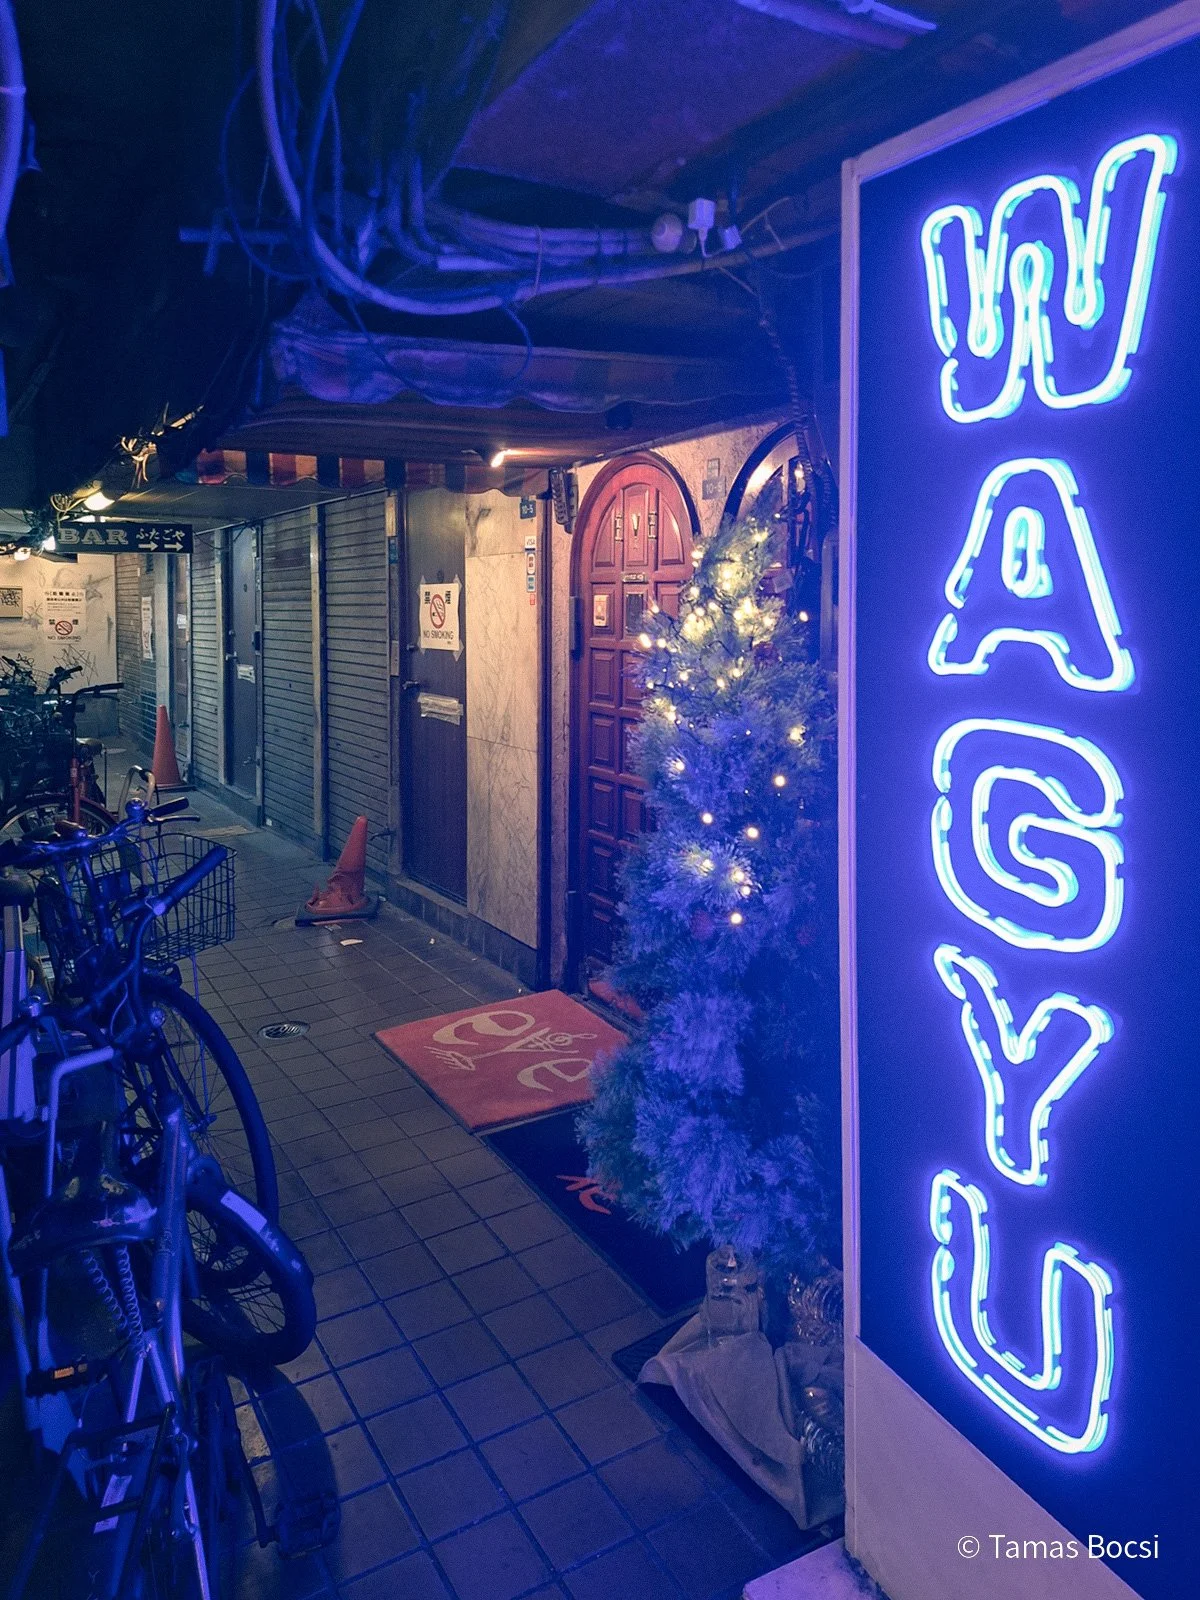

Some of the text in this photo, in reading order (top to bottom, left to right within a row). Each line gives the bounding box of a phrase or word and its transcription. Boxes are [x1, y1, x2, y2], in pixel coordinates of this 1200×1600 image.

[58, 528, 129, 545] BAR
[136, 528, 186, 541] ふたごや
[423, 630, 454, 640] NO SMOKING
[920, 133, 1178, 1454] WAGYU
